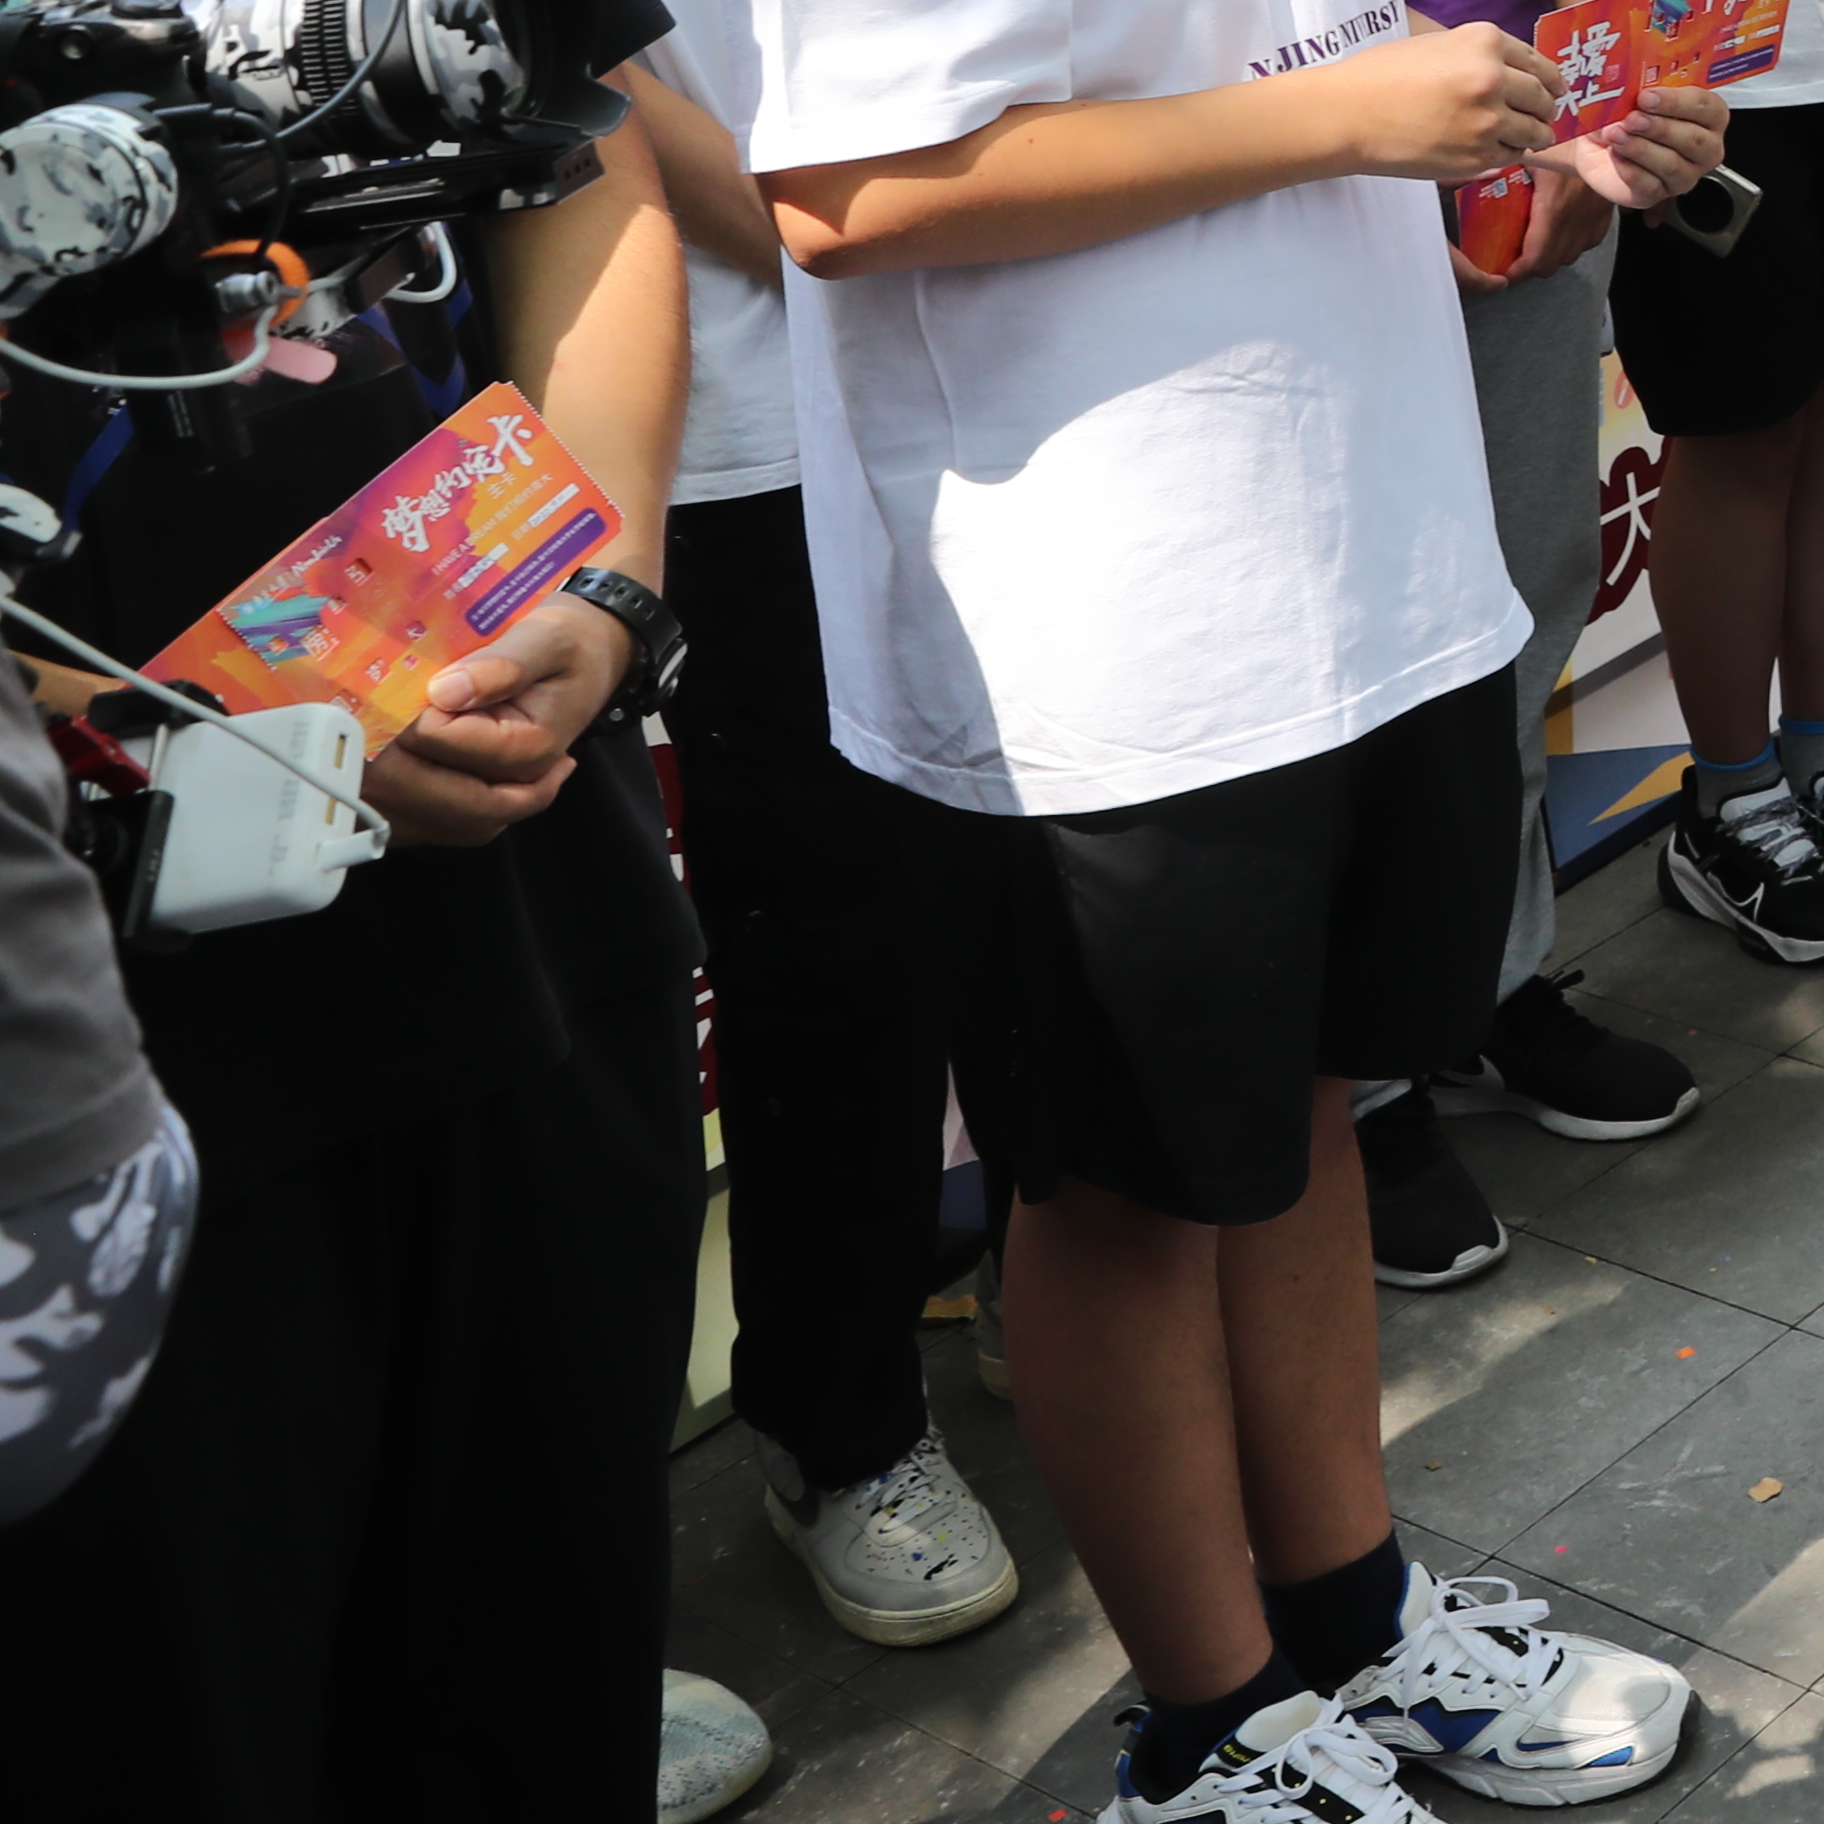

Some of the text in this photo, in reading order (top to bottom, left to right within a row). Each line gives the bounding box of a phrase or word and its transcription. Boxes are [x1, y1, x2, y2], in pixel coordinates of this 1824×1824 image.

[380, 414, 534, 553] 梦想约定卡
